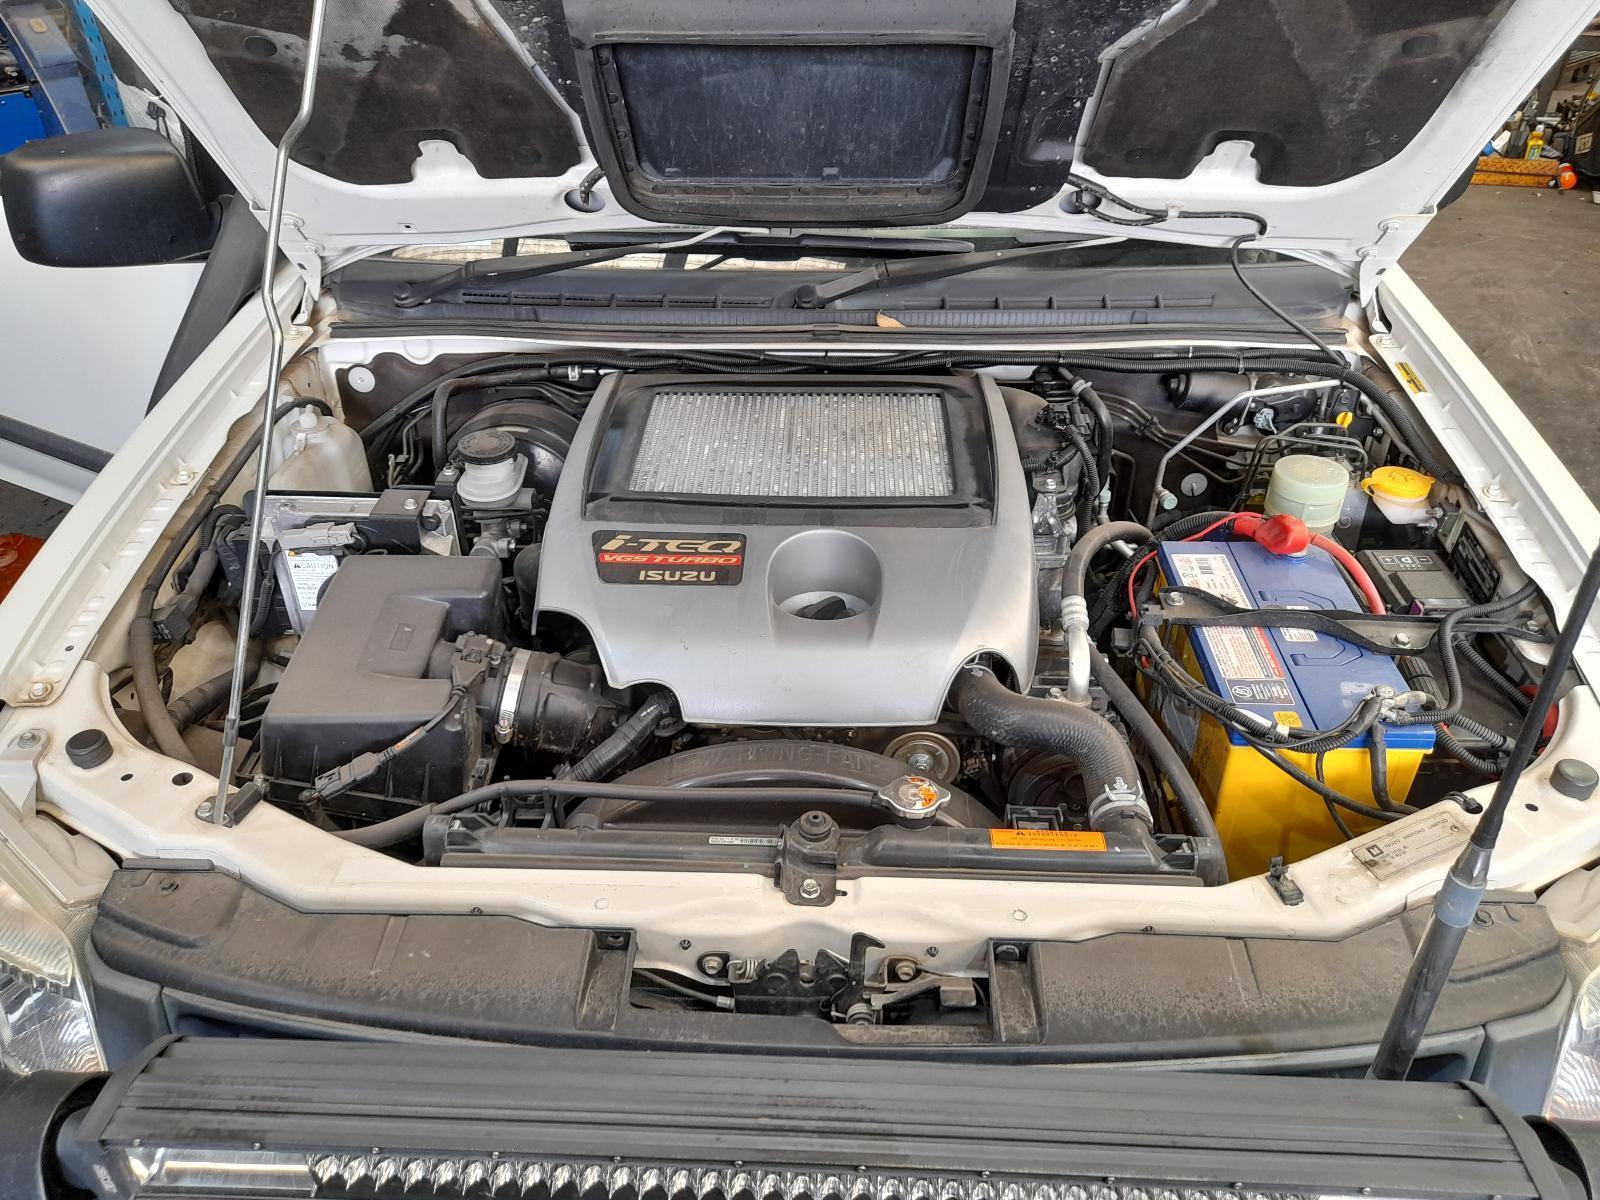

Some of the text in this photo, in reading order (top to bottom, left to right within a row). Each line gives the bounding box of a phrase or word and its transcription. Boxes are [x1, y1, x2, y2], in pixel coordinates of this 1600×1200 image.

[602, 534, 741, 553] i-TEQ
[604, 554, 738, 564] VGS TURBO
[639, 570, 716, 582] ISUZU
